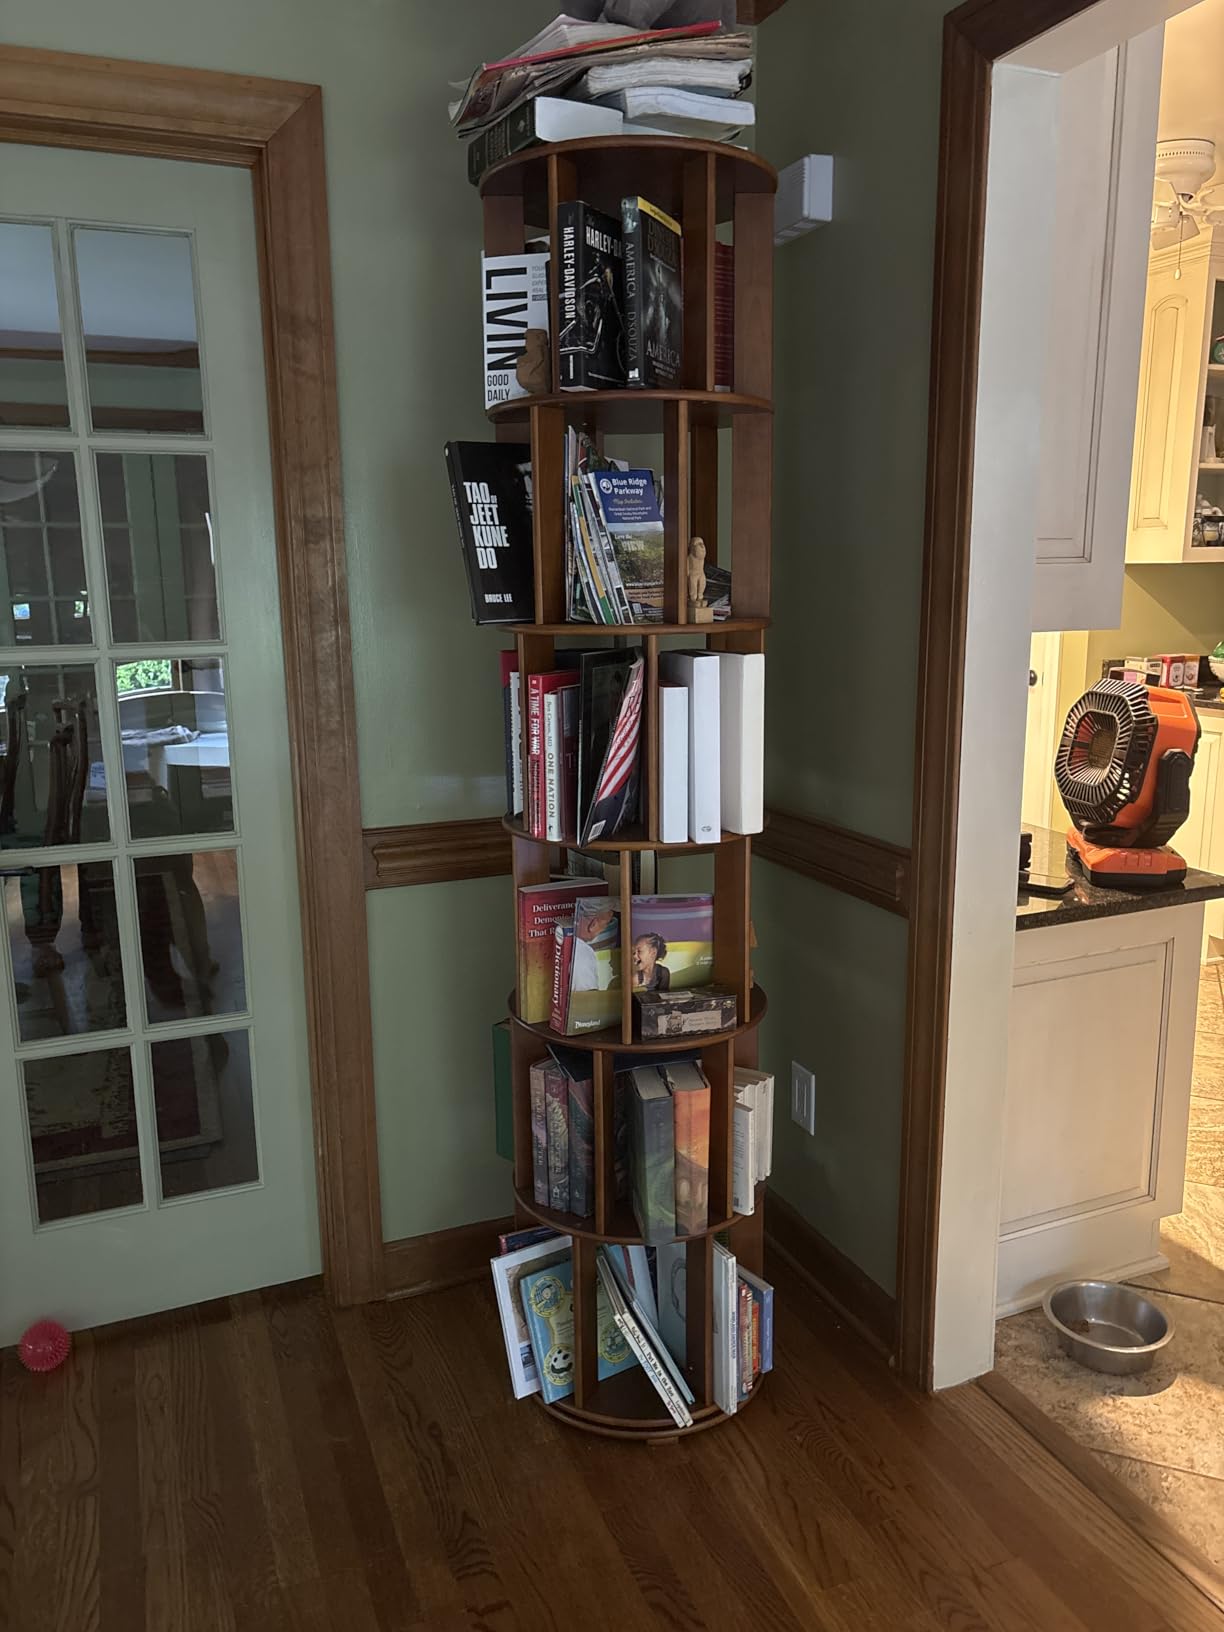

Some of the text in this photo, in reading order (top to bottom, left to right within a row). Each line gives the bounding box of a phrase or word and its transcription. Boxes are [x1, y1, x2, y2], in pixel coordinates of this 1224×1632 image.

[585, 225, 622, 258] HARLEY-DA
[563, 226, 576, 319] HARLEY-DAVIDSON
[625, 242, 636, 299] AMERICA
[486, 267, 528, 371] LIVIN
[646, 339, 680, 368] AMERICA
[487, 374, 509, 387] GOOD
[487, 388, 511, 402] DAILY
[463, 482, 490, 503] TAO
[611, 478, 647, 487] Blue Ridge
[613, 487, 643, 496] Parkway
[470, 504, 500, 525] JEET
[472, 525, 510, 548] KUNE
[476, 548, 498, 569] DO
[484, 593, 513, 604] BRUCE LEE
[530, 696, 540, 716] TIME
[531, 718, 540, 735] FOR
[531, 736, 540, 756] WAR
[532, 903, 575, 913] Deliveranc
[528, 928, 547, 938] That
[551, 944, 562, 1009] Dictionary
[645, 1351, 656, 1363] Put
[651, 1361, 660, 1370] Me
[660, 1377, 670, 1387] the
[666, 1386, 676, 1397] Zoo
